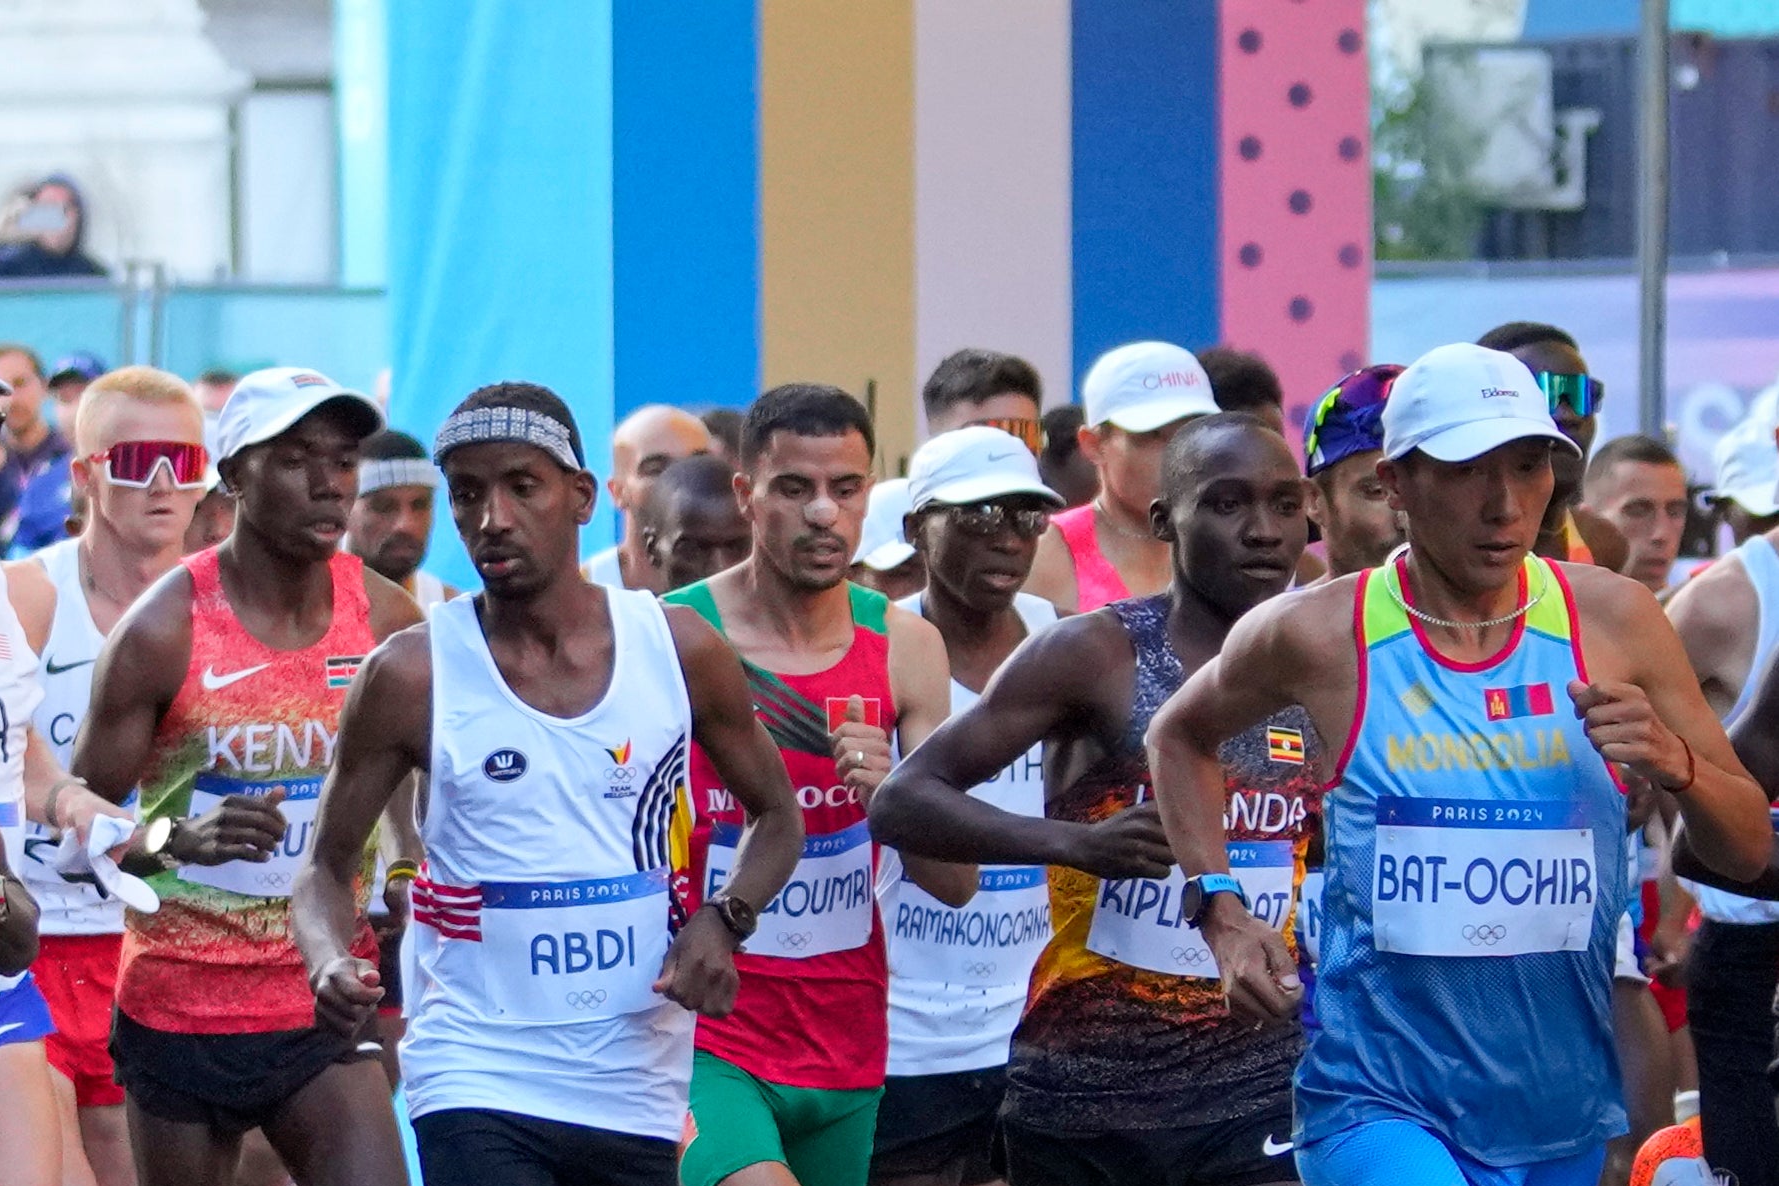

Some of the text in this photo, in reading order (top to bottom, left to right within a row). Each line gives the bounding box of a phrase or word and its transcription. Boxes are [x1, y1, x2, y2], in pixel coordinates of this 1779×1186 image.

[1386, 728, 1571, 772] MONGOLIA
[1432, 806, 1544, 821] PARIS 2024
[530, 883, 630, 902] PARIS 2024
[1377, 853, 1593, 906] BAT-OCHIR
[530, 925, 636, 976] ABDI
